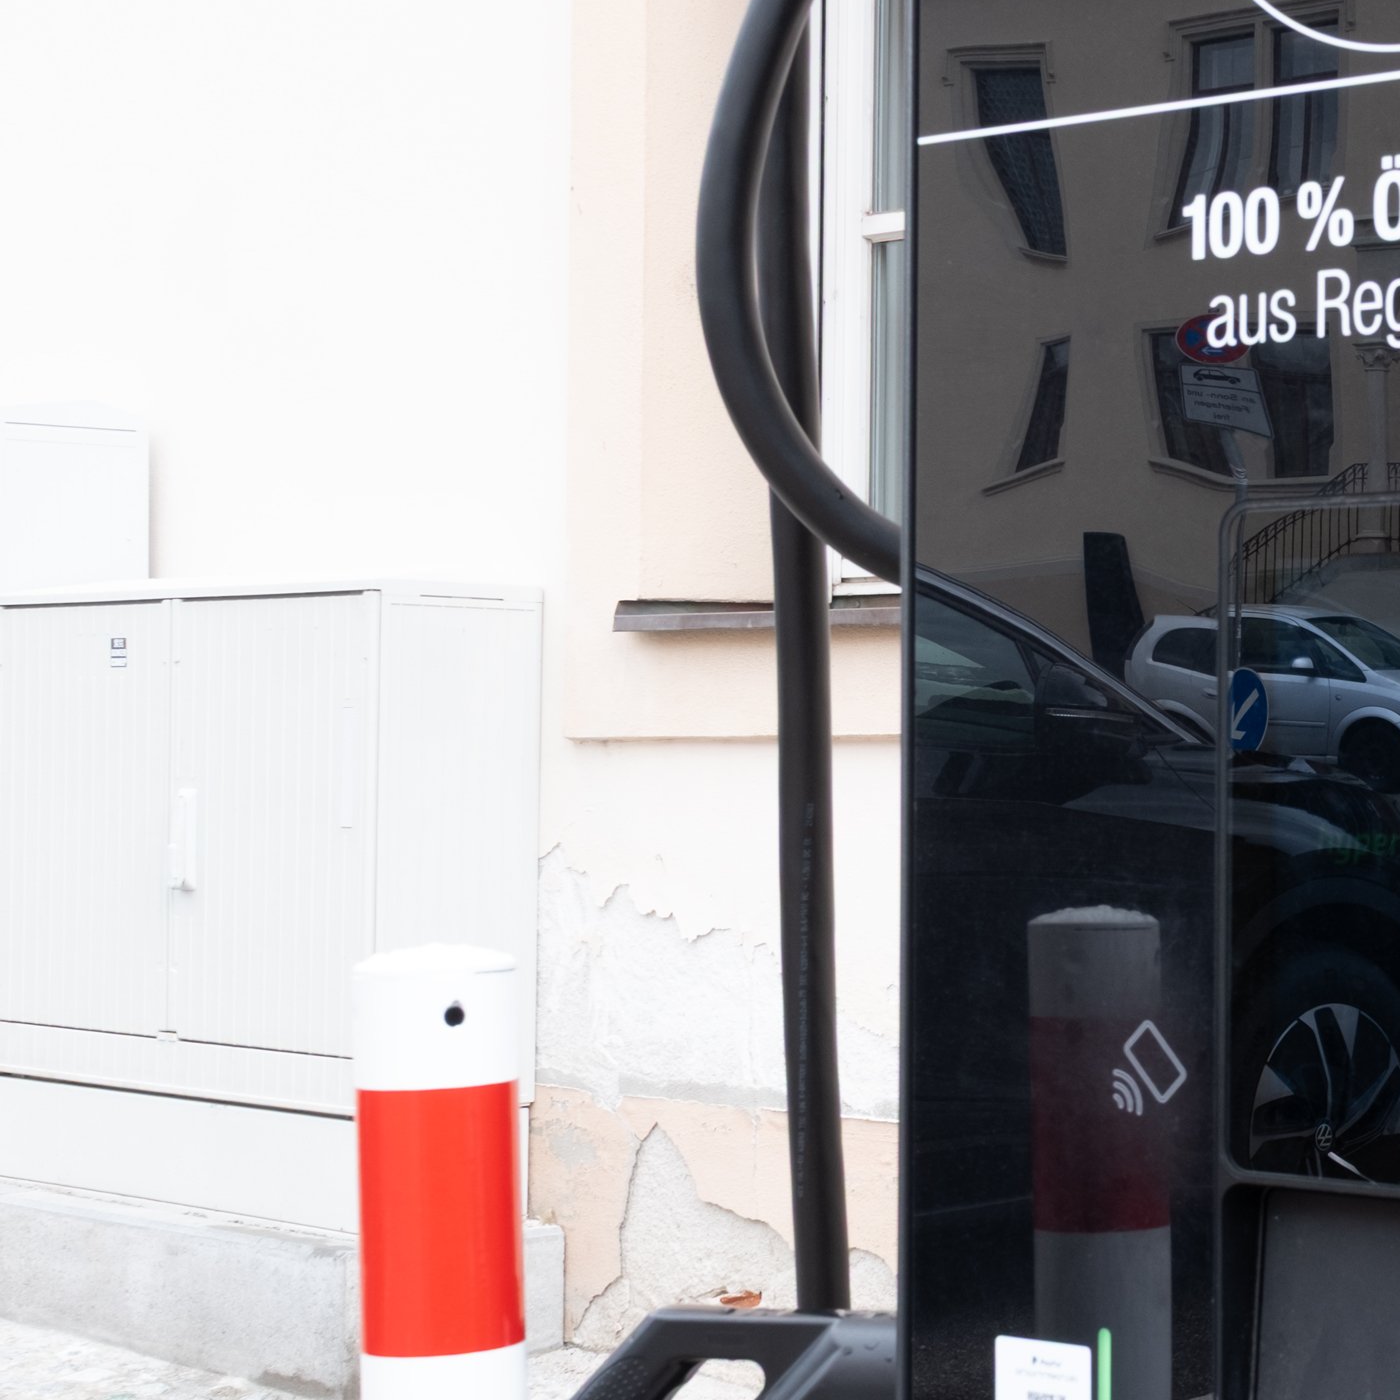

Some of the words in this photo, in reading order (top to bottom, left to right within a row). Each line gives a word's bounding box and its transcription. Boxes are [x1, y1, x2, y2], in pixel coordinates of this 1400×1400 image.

[1182, 194, 1280, 261] 100
[1297, 176, 1354, 252] %
[1207, 289, 1296, 349] aus
